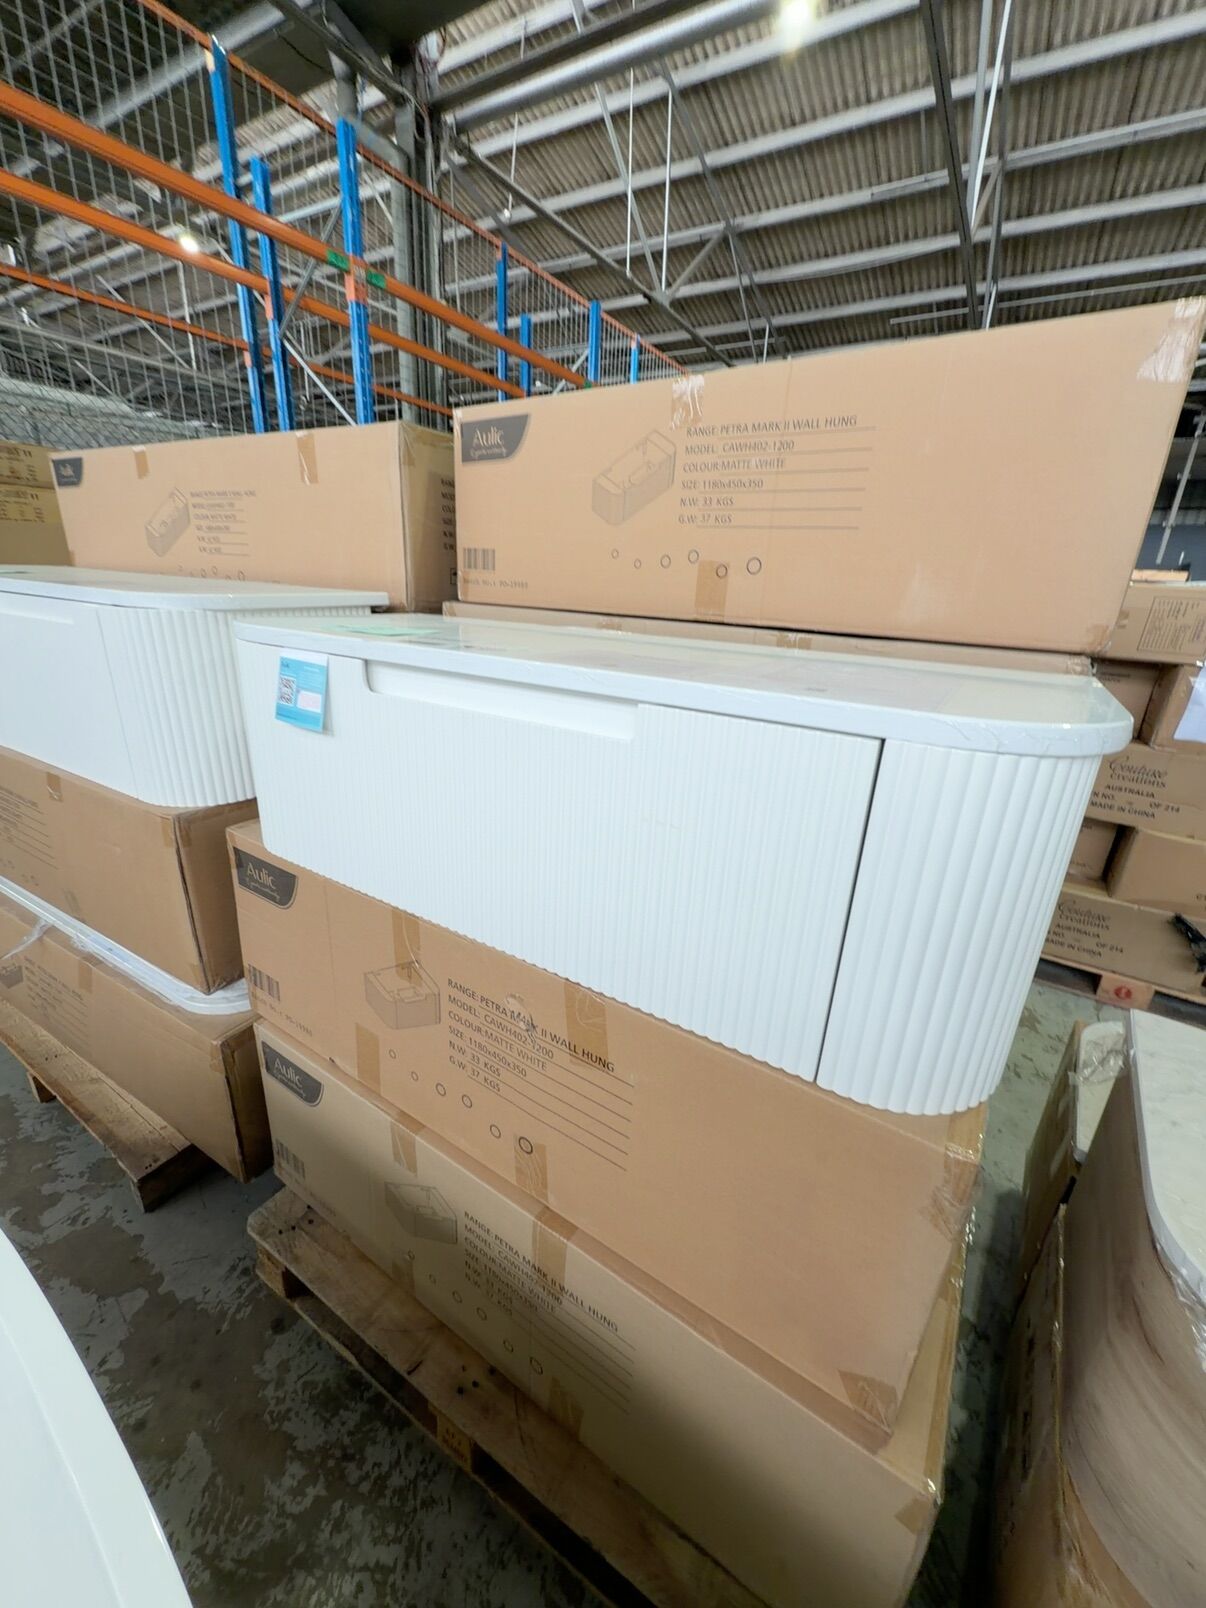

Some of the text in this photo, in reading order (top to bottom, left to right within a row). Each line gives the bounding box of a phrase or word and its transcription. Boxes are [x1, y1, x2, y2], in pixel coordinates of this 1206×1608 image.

[720, 422, 749, 435] PETRA
[751, 420, 781, 433] MARK
[792, 417, 821, 431] WALL
[824, 415, 858, 428] HUNG
[473, 426, 505, 447] Aulic
[754, 458, 785, 469] WHITE
[716, 496, 734, 506] KGS
[714, 513, 732, 524] KGS
[1105, 784, 1155, 798] AUSTRALIA
[1090, 800, 1115, 810] MADE
[1127, 807, 1156, 819] CHINA
[247, 862, 276, 889] Aulic
[480, 995, 508, 1017] PETRA
[549, 1032, 579, 1054] WALL
[582, 1048, 615, 1073] HUNG
[471, 1054, 480, 1065] 33
[484, 1061, 501, 1078] KGS
[516, 1047, 548, 1071] WHITE
[274, 1057, 303, 1089] Aulic
[471, 1066, 480, 1078] 37
[484, 1076, 501, 1092] KGS
[522, 1255, 548, 1281] MARK
[559, 1282, 584, 1307] WALL
[589, 1305, 618, 1333] HUNG
